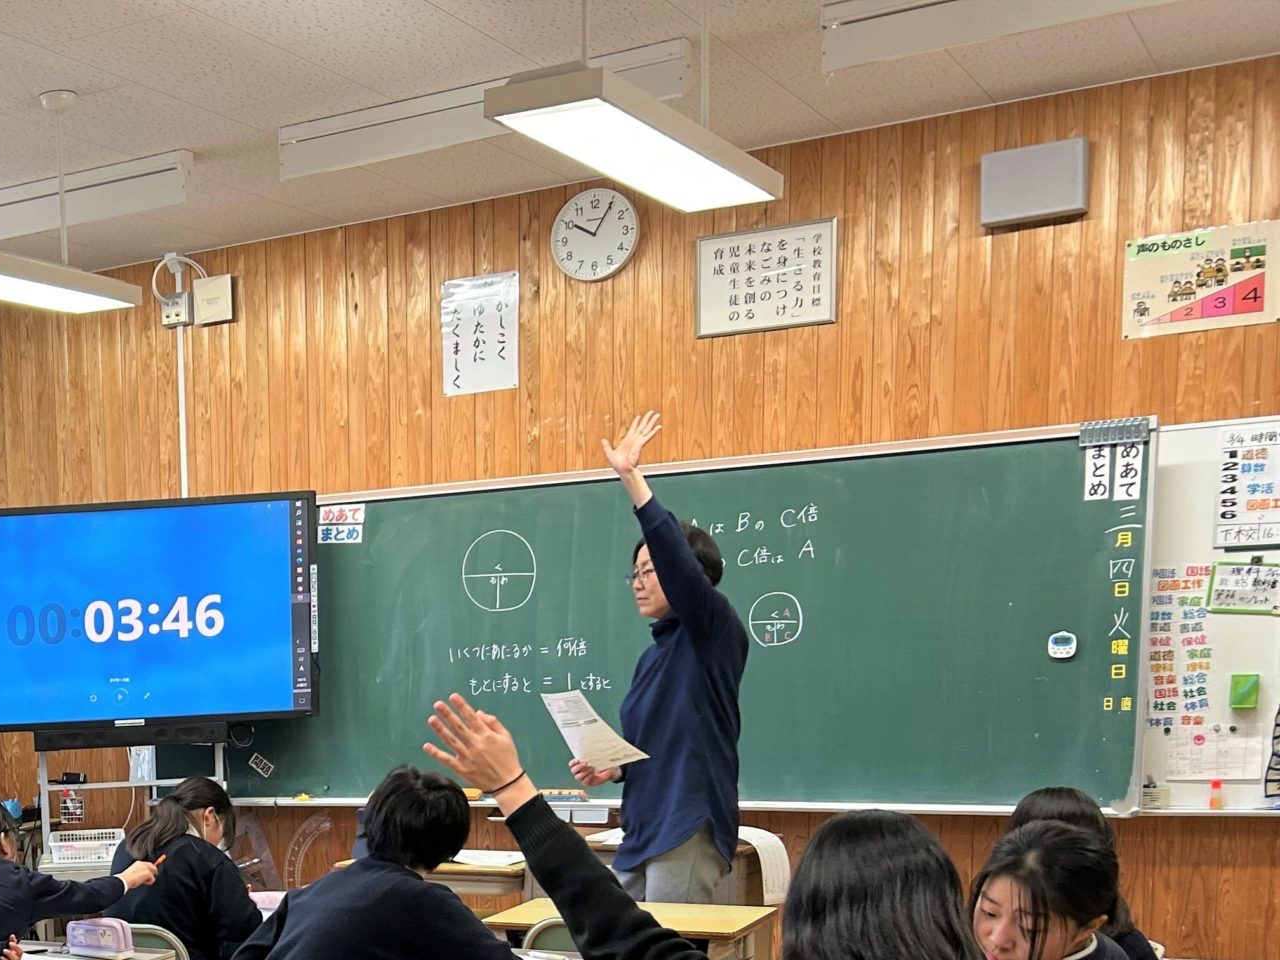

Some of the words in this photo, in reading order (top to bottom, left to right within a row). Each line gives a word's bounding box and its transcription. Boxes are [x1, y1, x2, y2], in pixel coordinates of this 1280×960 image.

[590, 199, 600, 209] 12
[575, 207, 583, 216] 11
[617, 210, 625, 220] 2
[564, 220, 574, 230] 10
[622, 225, 630, 235] 3
[561, 237, 568, 246] 9
[617, 242, 624, 251] 4
[1136, 236, 1206, 255] 声のものさし
[566, 251, 573, 261] 8
[606, 255, 613, 265] 5
[713, 248, 724, 276] 育成
[578, 260, 584, 270] 7
[591, 261, 598, 271] 6
[812, 233, 823, 307] 学校教育目標
[760, 242, 772, 302] なごみの
[776, 239, 788, 317] を身につけ
[728, 245, 740, 322] 児童生徒の
[744, 243, 756, 320] 未来を創る
[1242, 287, 1262, 303] 4
[1213, 296, 1227, 309] 3
[1183, 307, 1193, 316] 2
[473, 304, 486, 363] ゆたかに
[496, 300, 508, 360] かしこく
[451, 308, 462, 389] たくましく
[1250, 431, 1280, 443] 時間
[1223, 450, 1238, 459] 1
[1241, 447, 1269, 460] 道徳
[1088, 444, 1107, 496] まとめ
[1120, 444, 1140, 496] めあて
[1222, 461, 1239, 472] 2
[1241, 462, 1266, 473] 算数
[1221, 473, 1238, 484] 3
[1220, 485, 1238, 495] 4
[1247, 482, 1275, 495] 学活
[1220, 497, 1238, 508] 5
[1246, 498, 1280, 511] 図画工
[322, 505, 362, 522] めあて
[1220, 510, 1238, 520] 6
[321, 526, 360, 542] まとめ
[798, 539, 816, 559] A
[1186, 566, 1212, 576] 国語
[1157, 579, 1204, 591] 図画工作
[1182, 607, 1208, 619] 総合
[1180, 621, 1204, 633] 書道
[1181, 634, 1207, 646] 保健
[556, 637, 588, 657] 何倍
[1182, 672, 1208, 685] 総合
[1154, 687, 1179, 699] 国語
[1183, 686, 1207, 698] 社会
[1153, 701, 1177, 711] 社会
